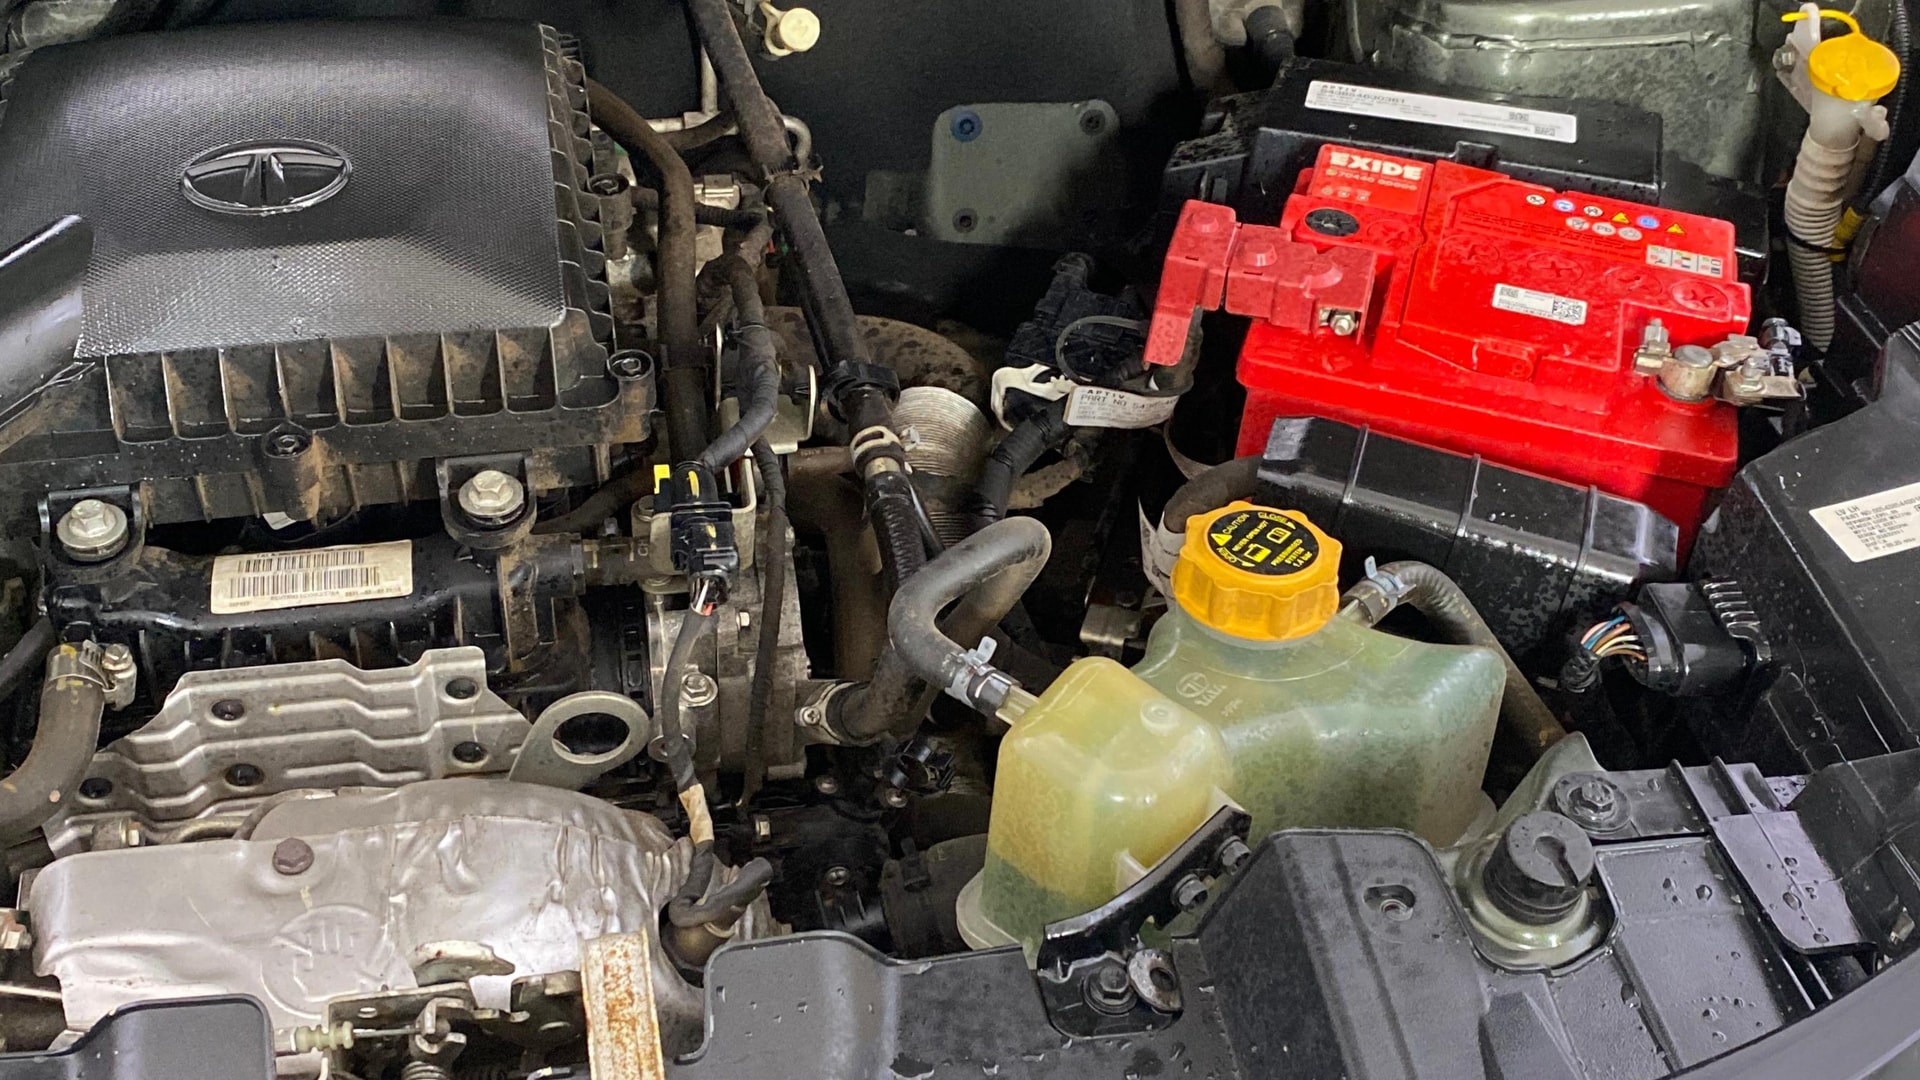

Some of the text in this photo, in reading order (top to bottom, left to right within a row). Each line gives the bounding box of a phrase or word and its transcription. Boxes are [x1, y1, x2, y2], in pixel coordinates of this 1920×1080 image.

[1330, 151, 1423, 181] EXIDE
[1080, 394, 1107, 404] PART
[1087, 389, 1125, 399] APTIV
[1222, 513, 1250, 535] CAUTION
[1257, 511, 1288, 524] CLOSE
